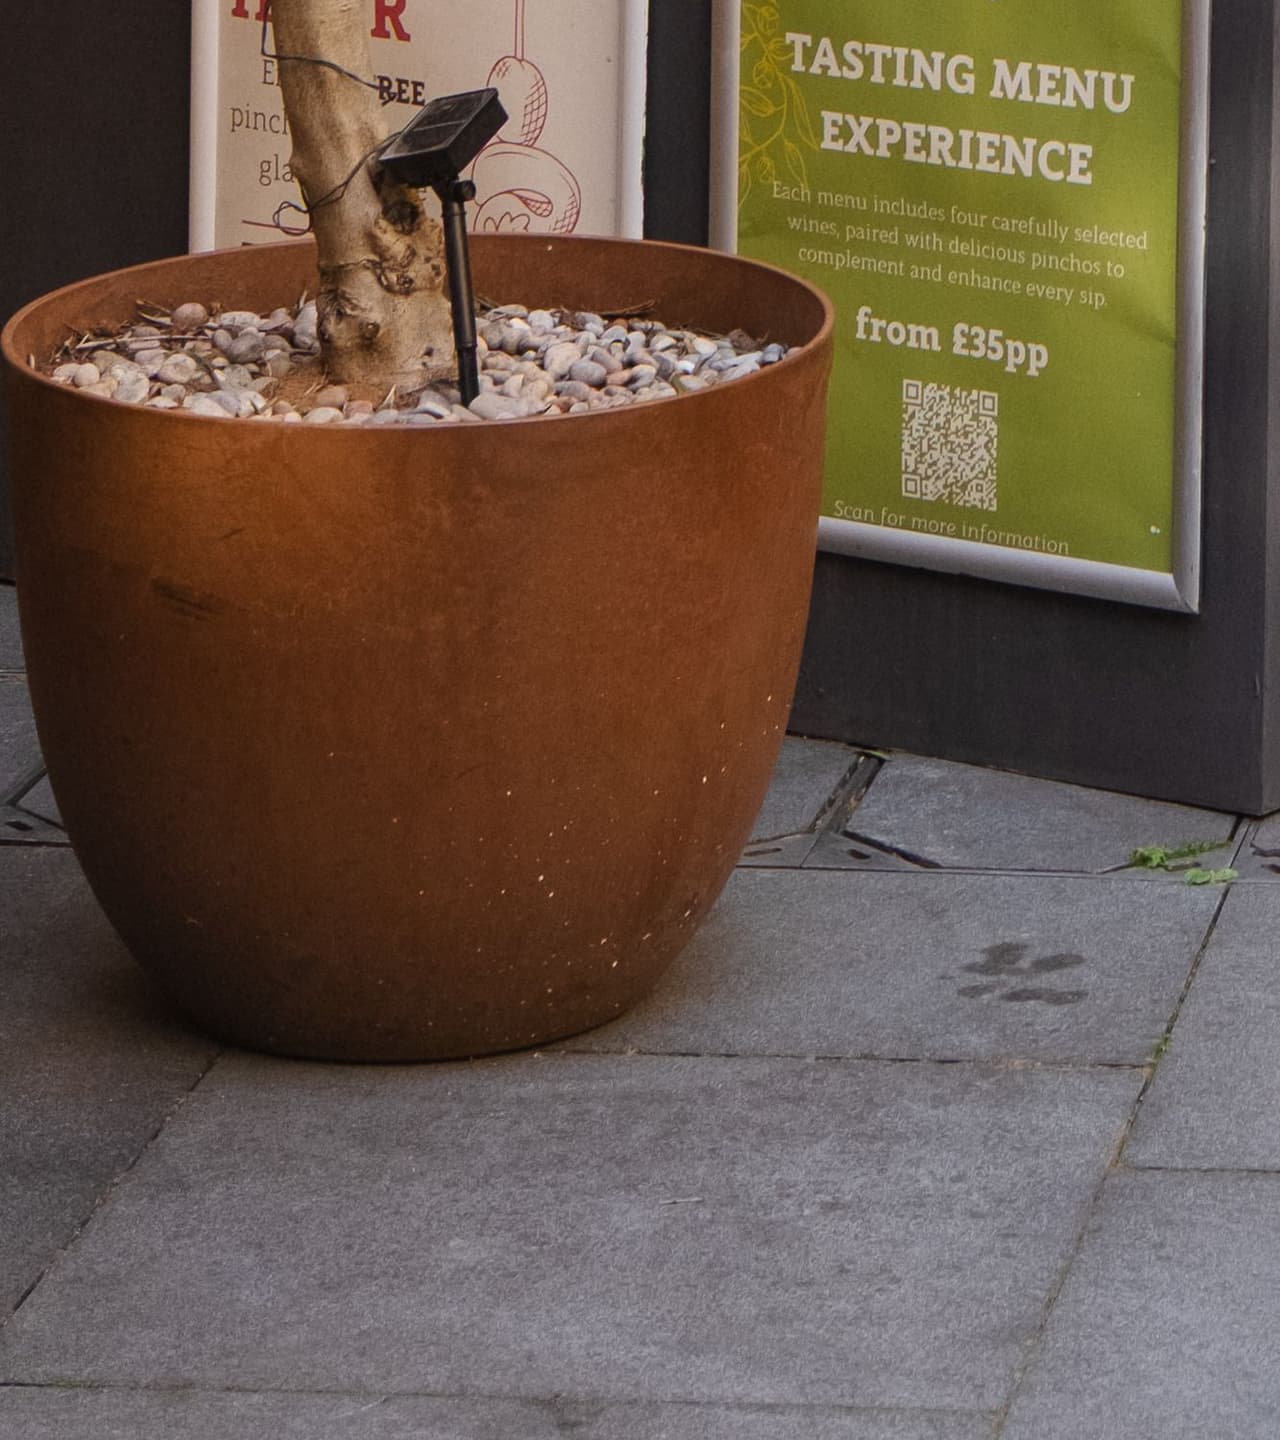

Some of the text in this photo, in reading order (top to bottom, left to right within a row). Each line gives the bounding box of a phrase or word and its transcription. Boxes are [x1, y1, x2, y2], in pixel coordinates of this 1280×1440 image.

[376, 75, 426, 107] REE
[785, 32, 1135, 113] TASTING MENU
[259, 153, 295, 186] gla
[820, 110, 1093, 185] EXPERIENCE
[772, 180, 1148, 250] Each menu includes four carefully selected
[787, 214, 1125, 278] wines, paired with delicious pinchos to
[799, 246, 1108, 309] complement and enhance every sip.
[855, 306, 1049, 376] from £35pp
[834, 500, 1070, 555] Scan for more information
